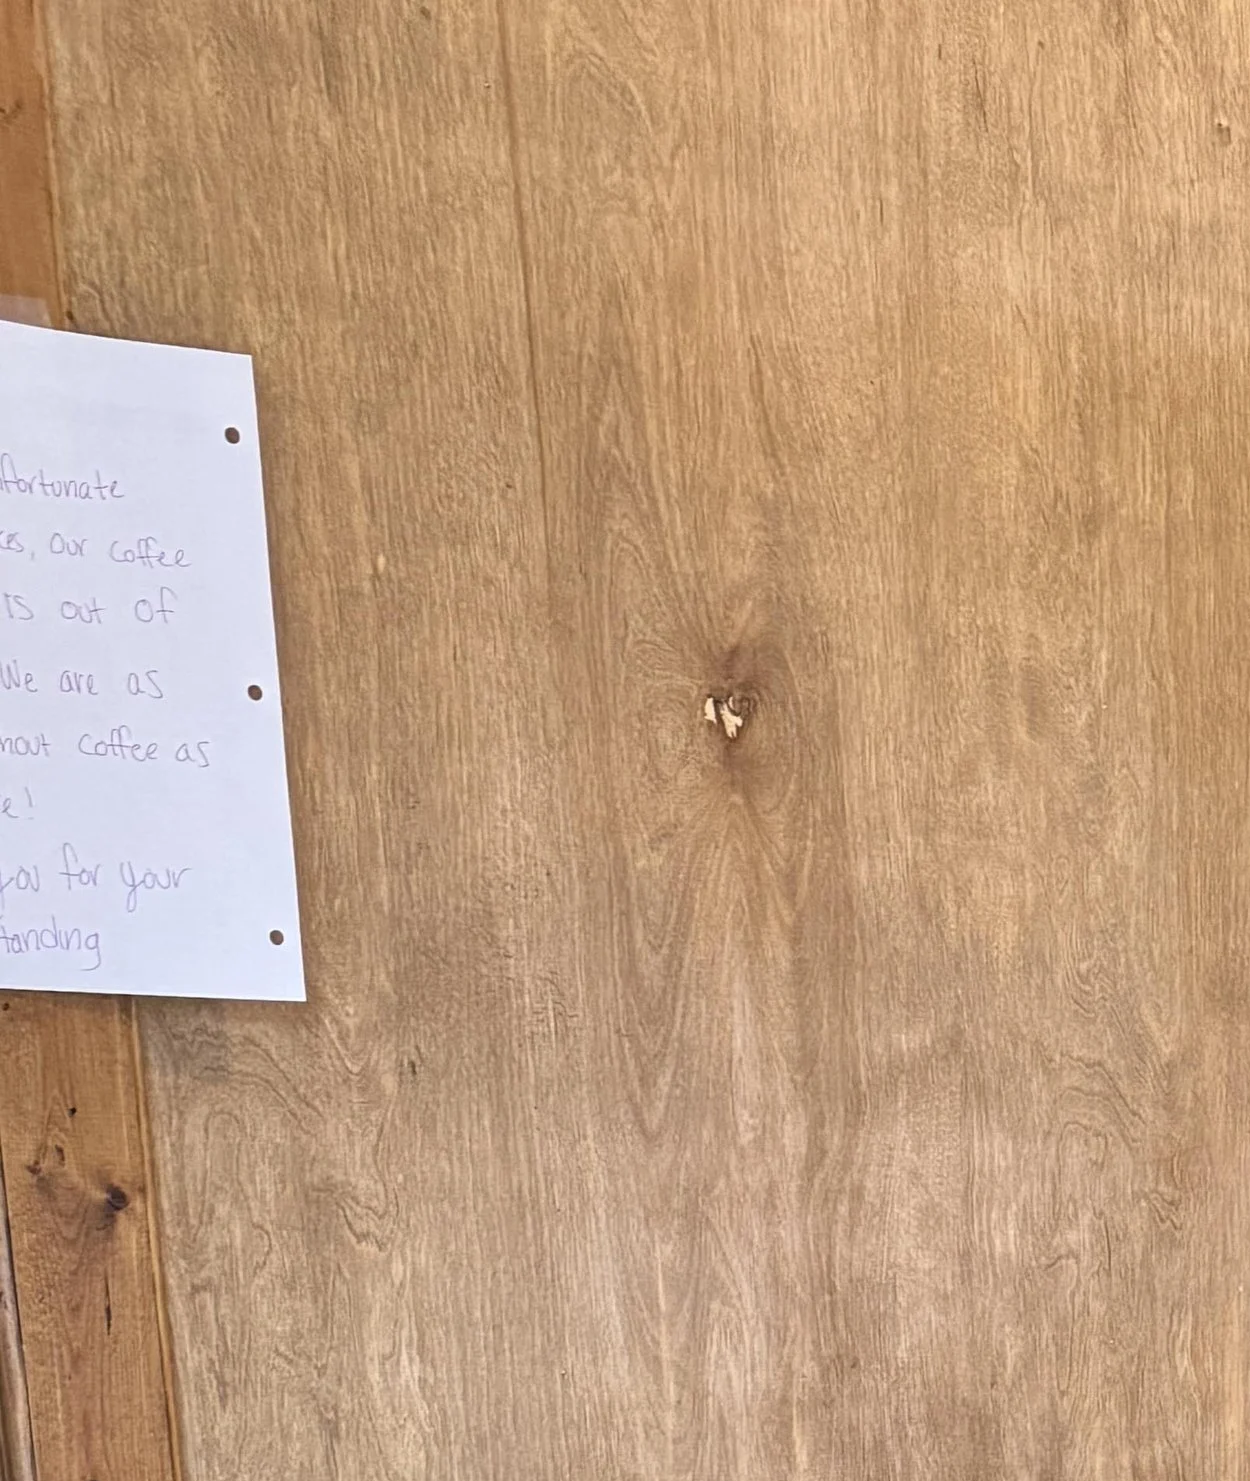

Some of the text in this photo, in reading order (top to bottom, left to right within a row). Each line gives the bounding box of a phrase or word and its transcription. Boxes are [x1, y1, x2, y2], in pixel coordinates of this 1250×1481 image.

[0, 453, 125, 500] fortunate
[60, 670, 99, 695] are
[127, 670, 163, 699] as
[175, 741, 210, 767] as
[59, 842, 100, 890] for
[119, 861, 192, 913] your
